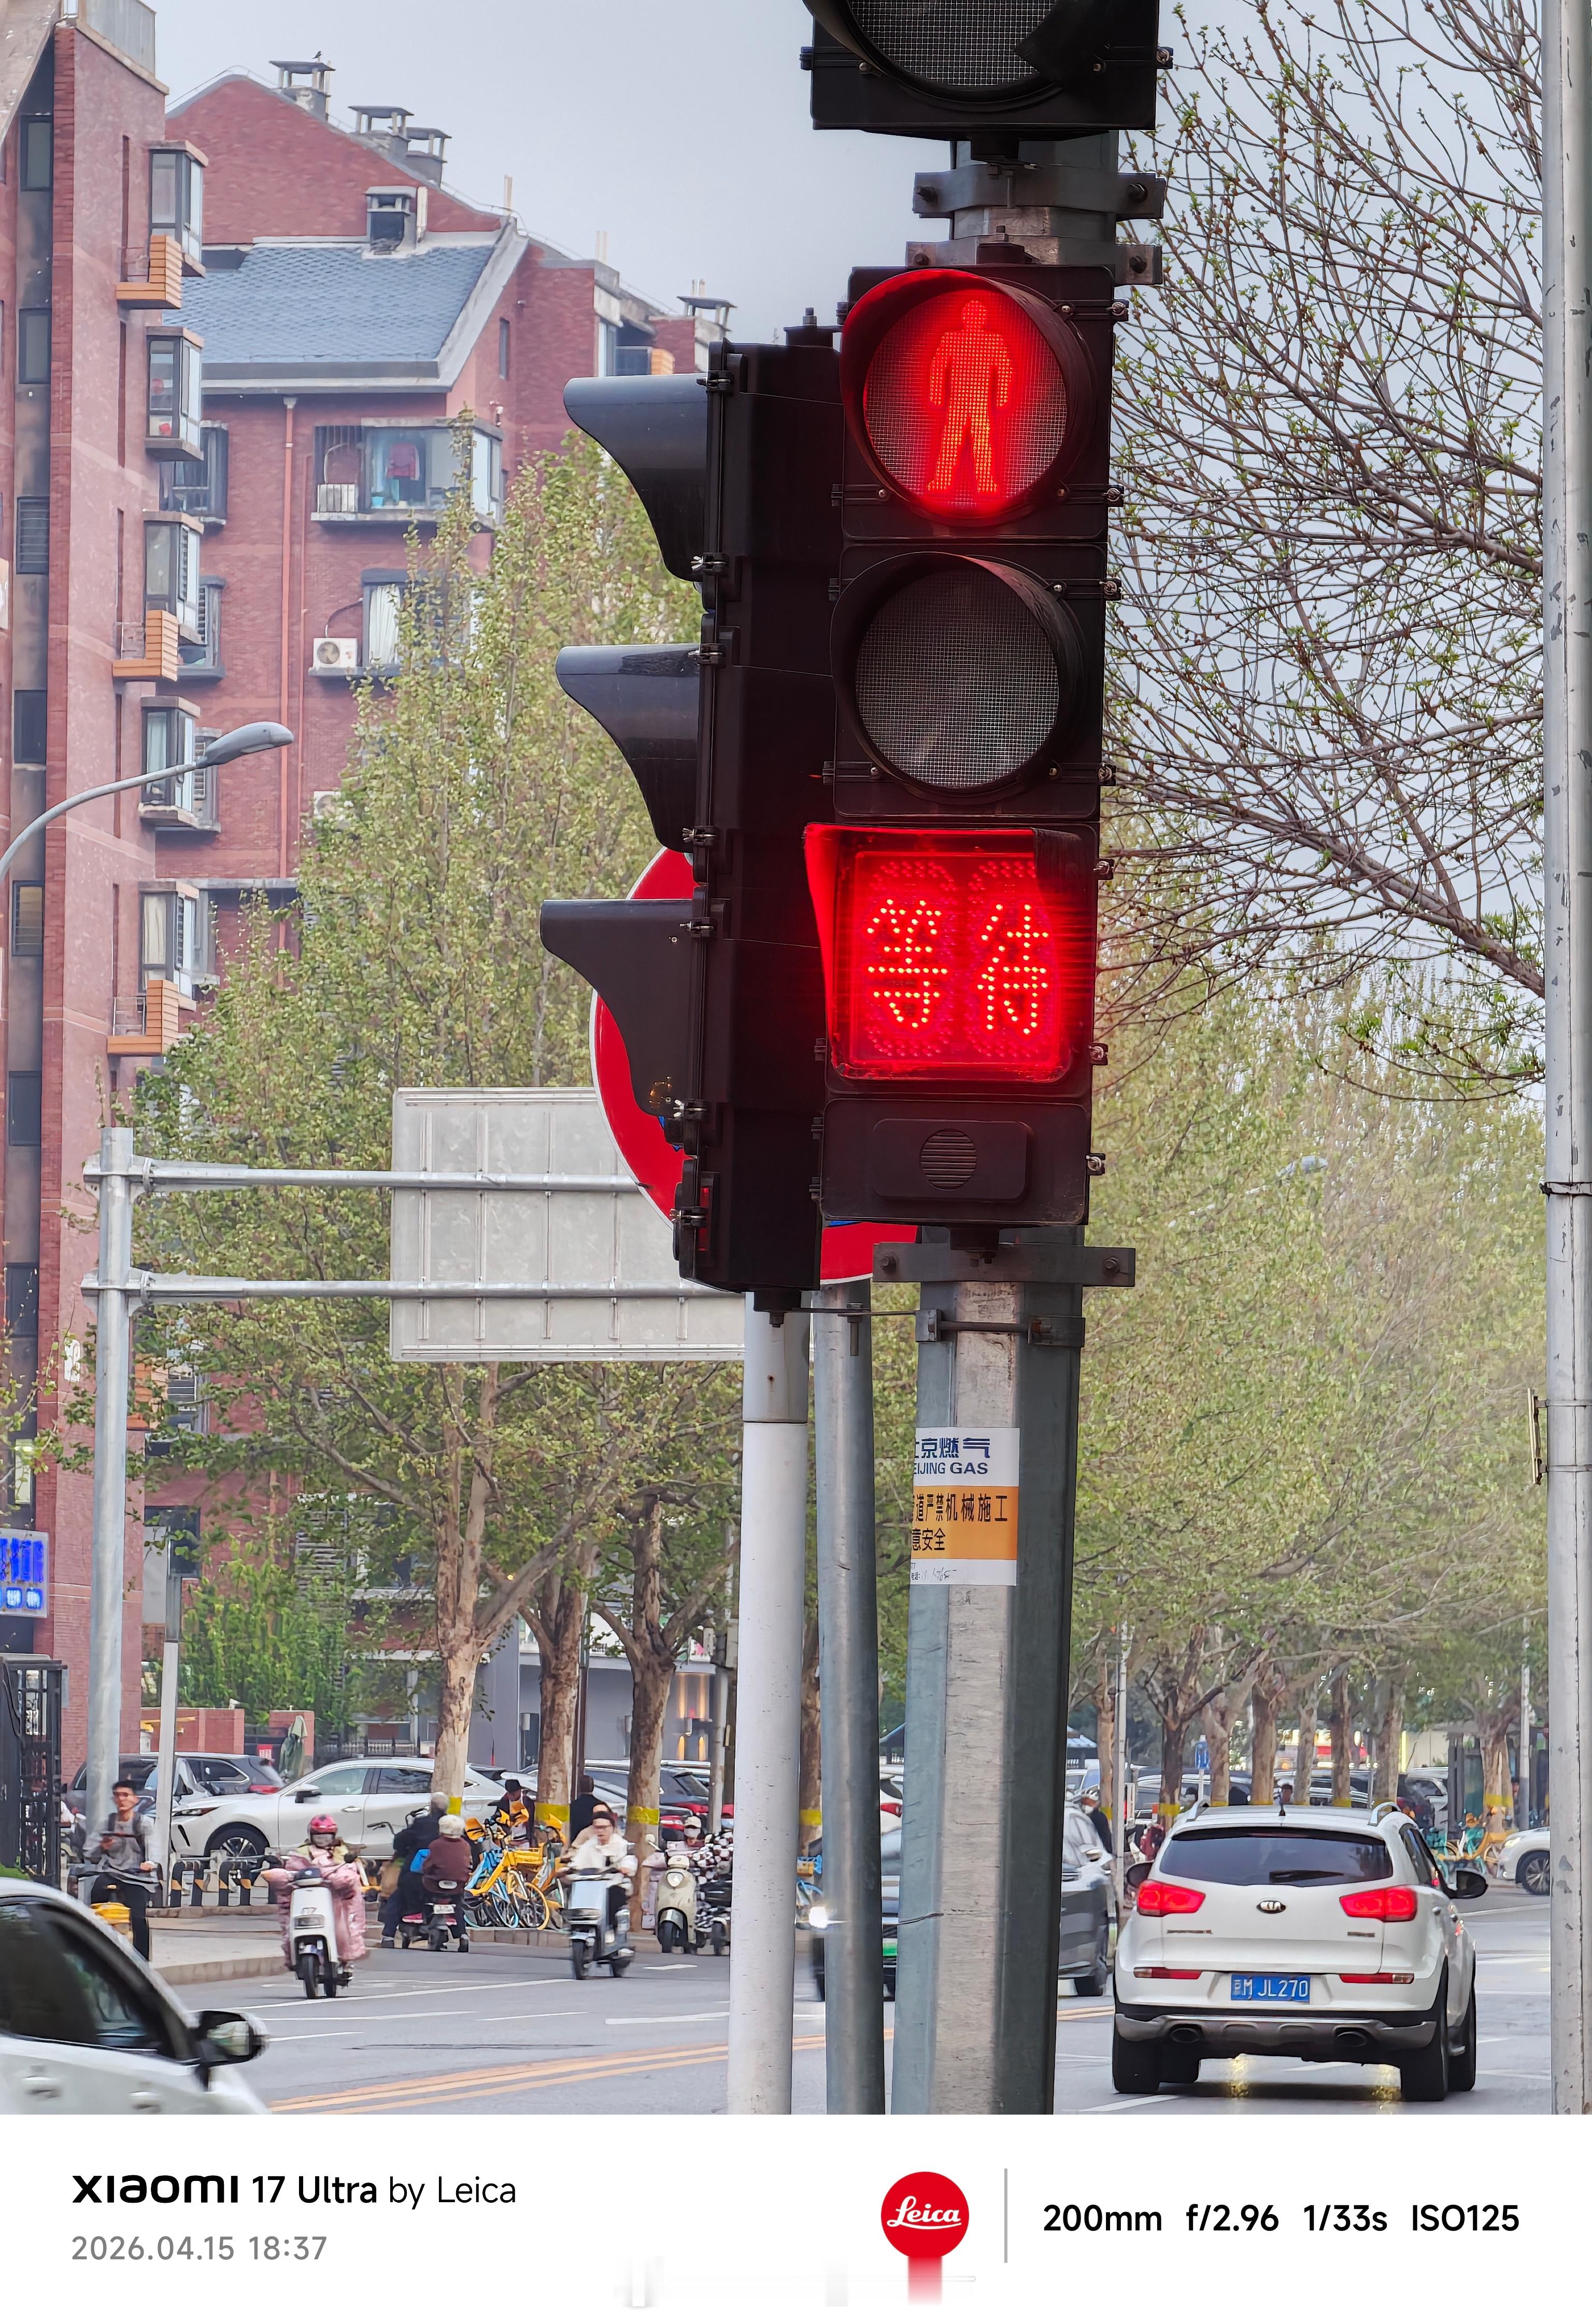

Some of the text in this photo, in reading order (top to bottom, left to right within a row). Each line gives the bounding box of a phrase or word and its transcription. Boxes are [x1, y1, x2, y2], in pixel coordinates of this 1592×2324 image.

[866, 898, 1050, 1035] 等待
[950, 1462, 988, 1475] GAS
[913, 1493, 1008, 1522] 道严禁机械施工
[1257, 1979, 1308, 1997] JL270
